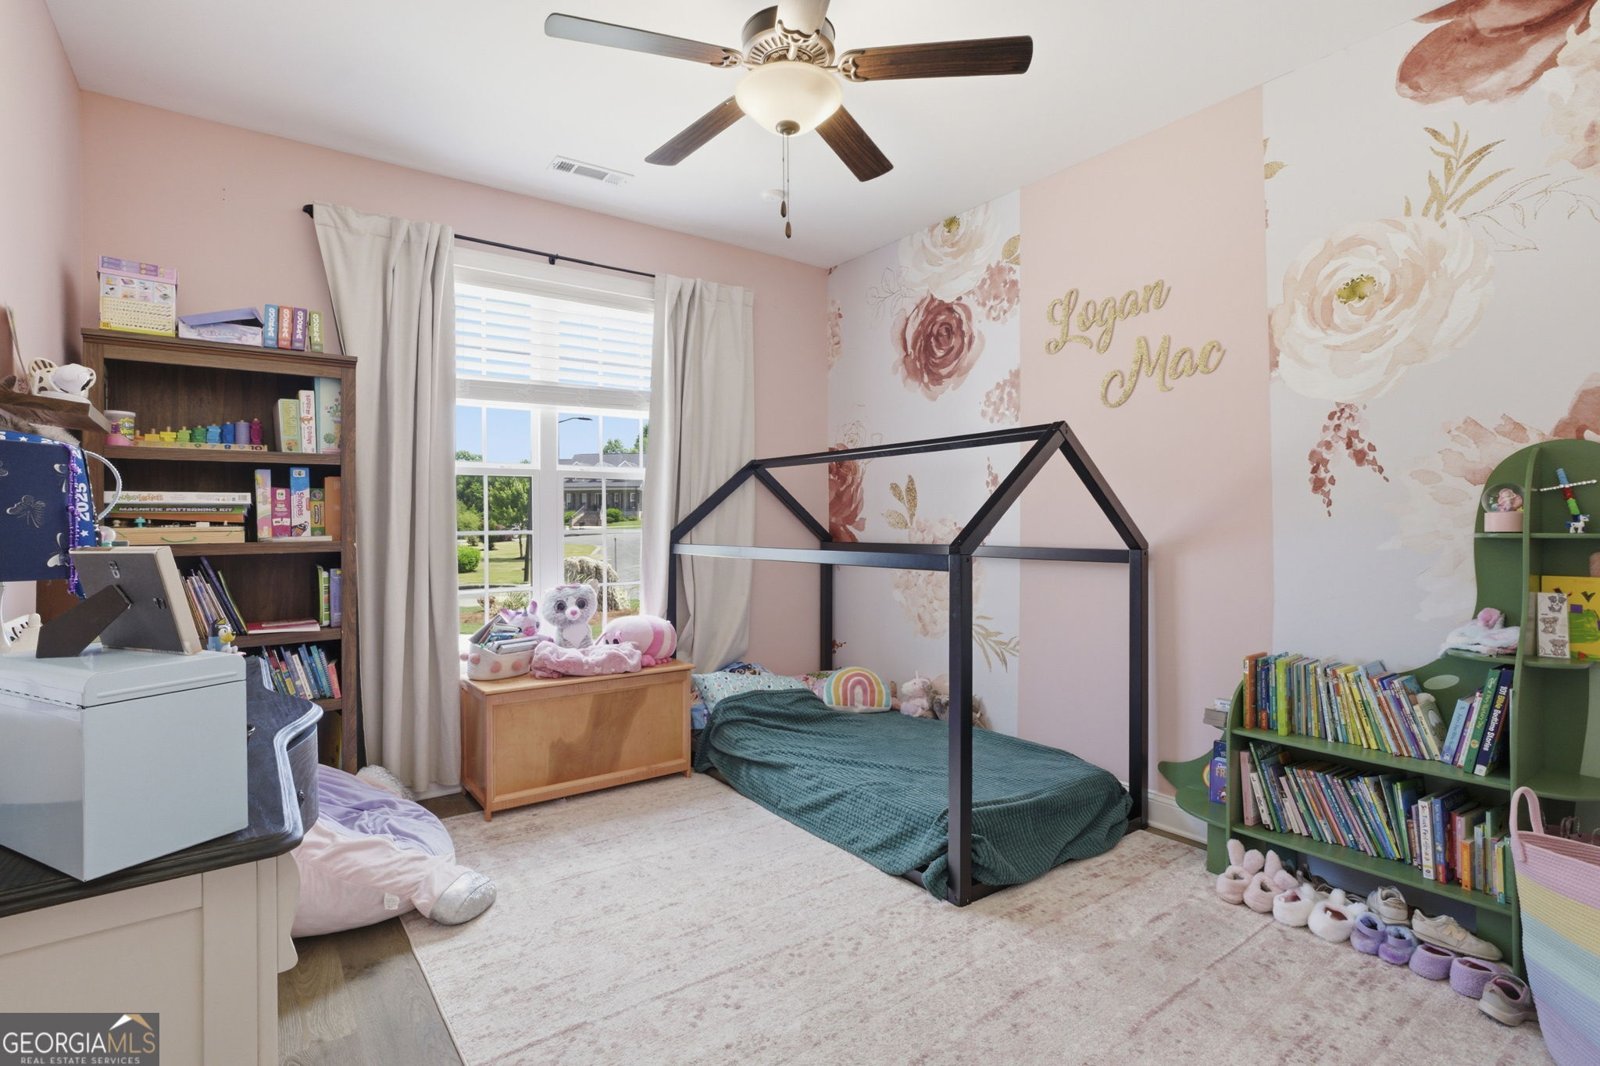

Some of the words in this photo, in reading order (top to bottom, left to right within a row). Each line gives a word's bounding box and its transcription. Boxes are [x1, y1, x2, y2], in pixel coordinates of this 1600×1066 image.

[1045, 279, 1171, 355] Logan
[1101, 334, 1226, 408] Mac
[75, 482, 91, 522] 2025
[296, 491, 305, 516] Shapes
[1495, 695, 1505, 709] Bible
[1489, 709, 1501, 732] Bedtime
[1483, 732, 1494, 751] Stories
